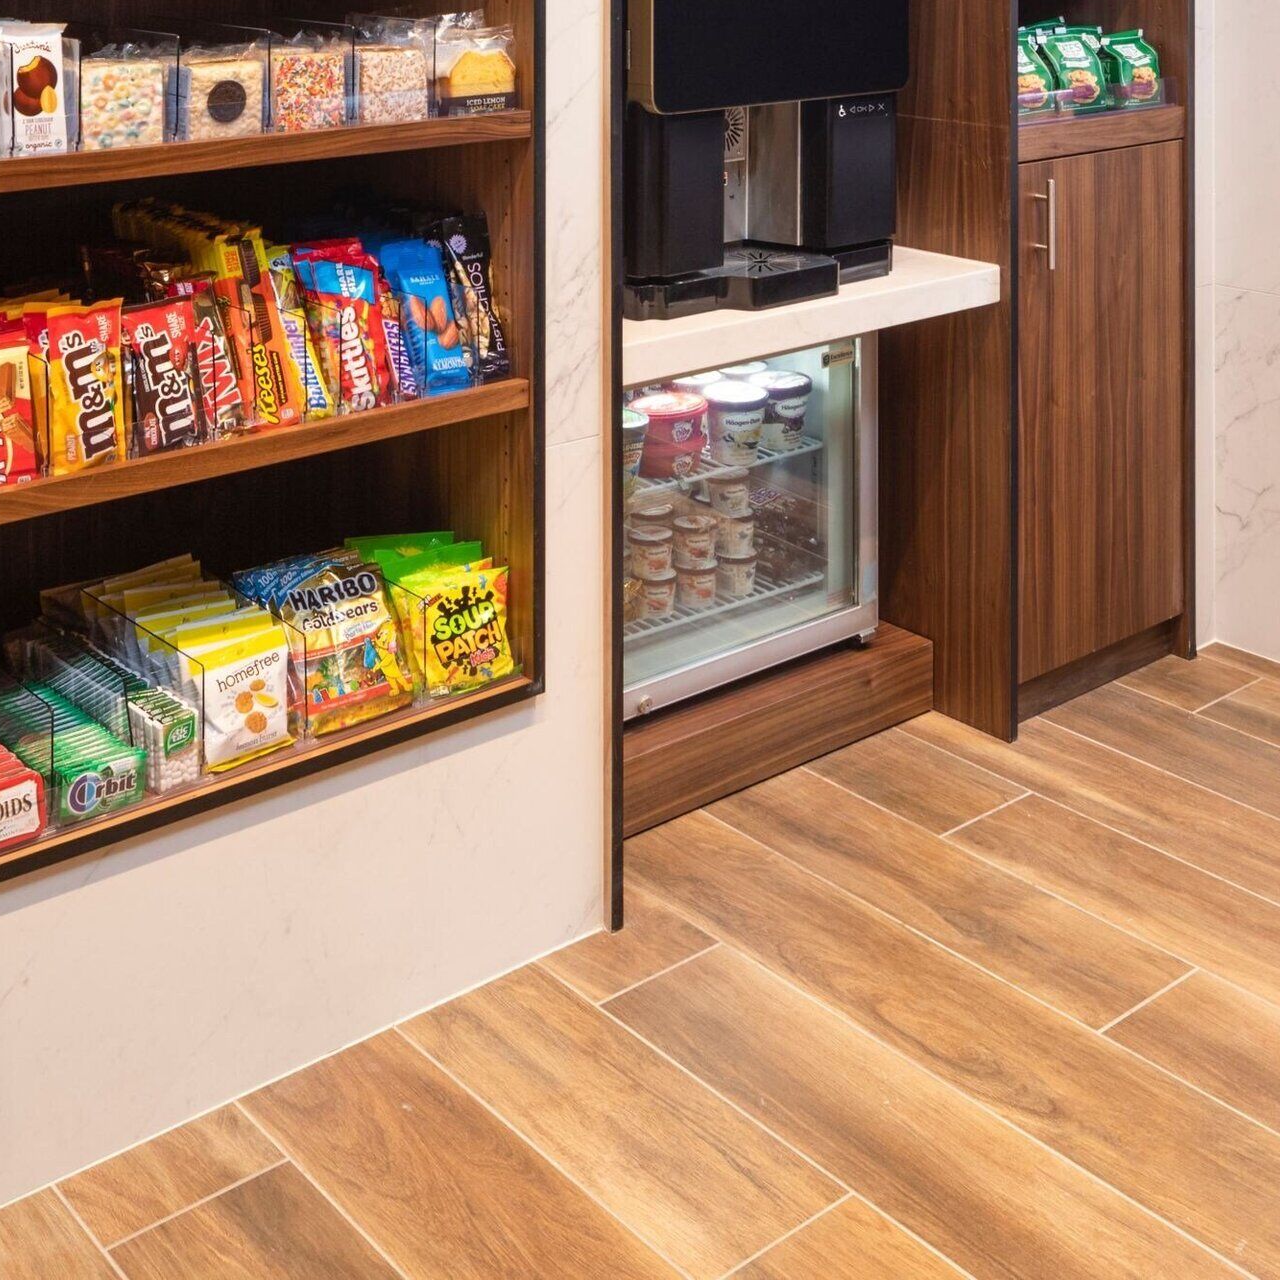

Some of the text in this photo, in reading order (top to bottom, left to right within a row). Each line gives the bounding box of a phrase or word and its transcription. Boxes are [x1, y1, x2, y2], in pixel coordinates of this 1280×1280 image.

[466, 97, 506, 107] ICED LEMON
[335, 262, 350, 298] SHARE
[96, 314, 110, 340] SHARE
[166, 311, 180, 339] SHARE
[288, 572, 378, 612] HARIBO
[434, 600, 496, 641] SOUR
[435, 621, 503, 665] PATCH
[216, 650, 280, 694] homefree
[69, 769, 137, 815] Orbit
